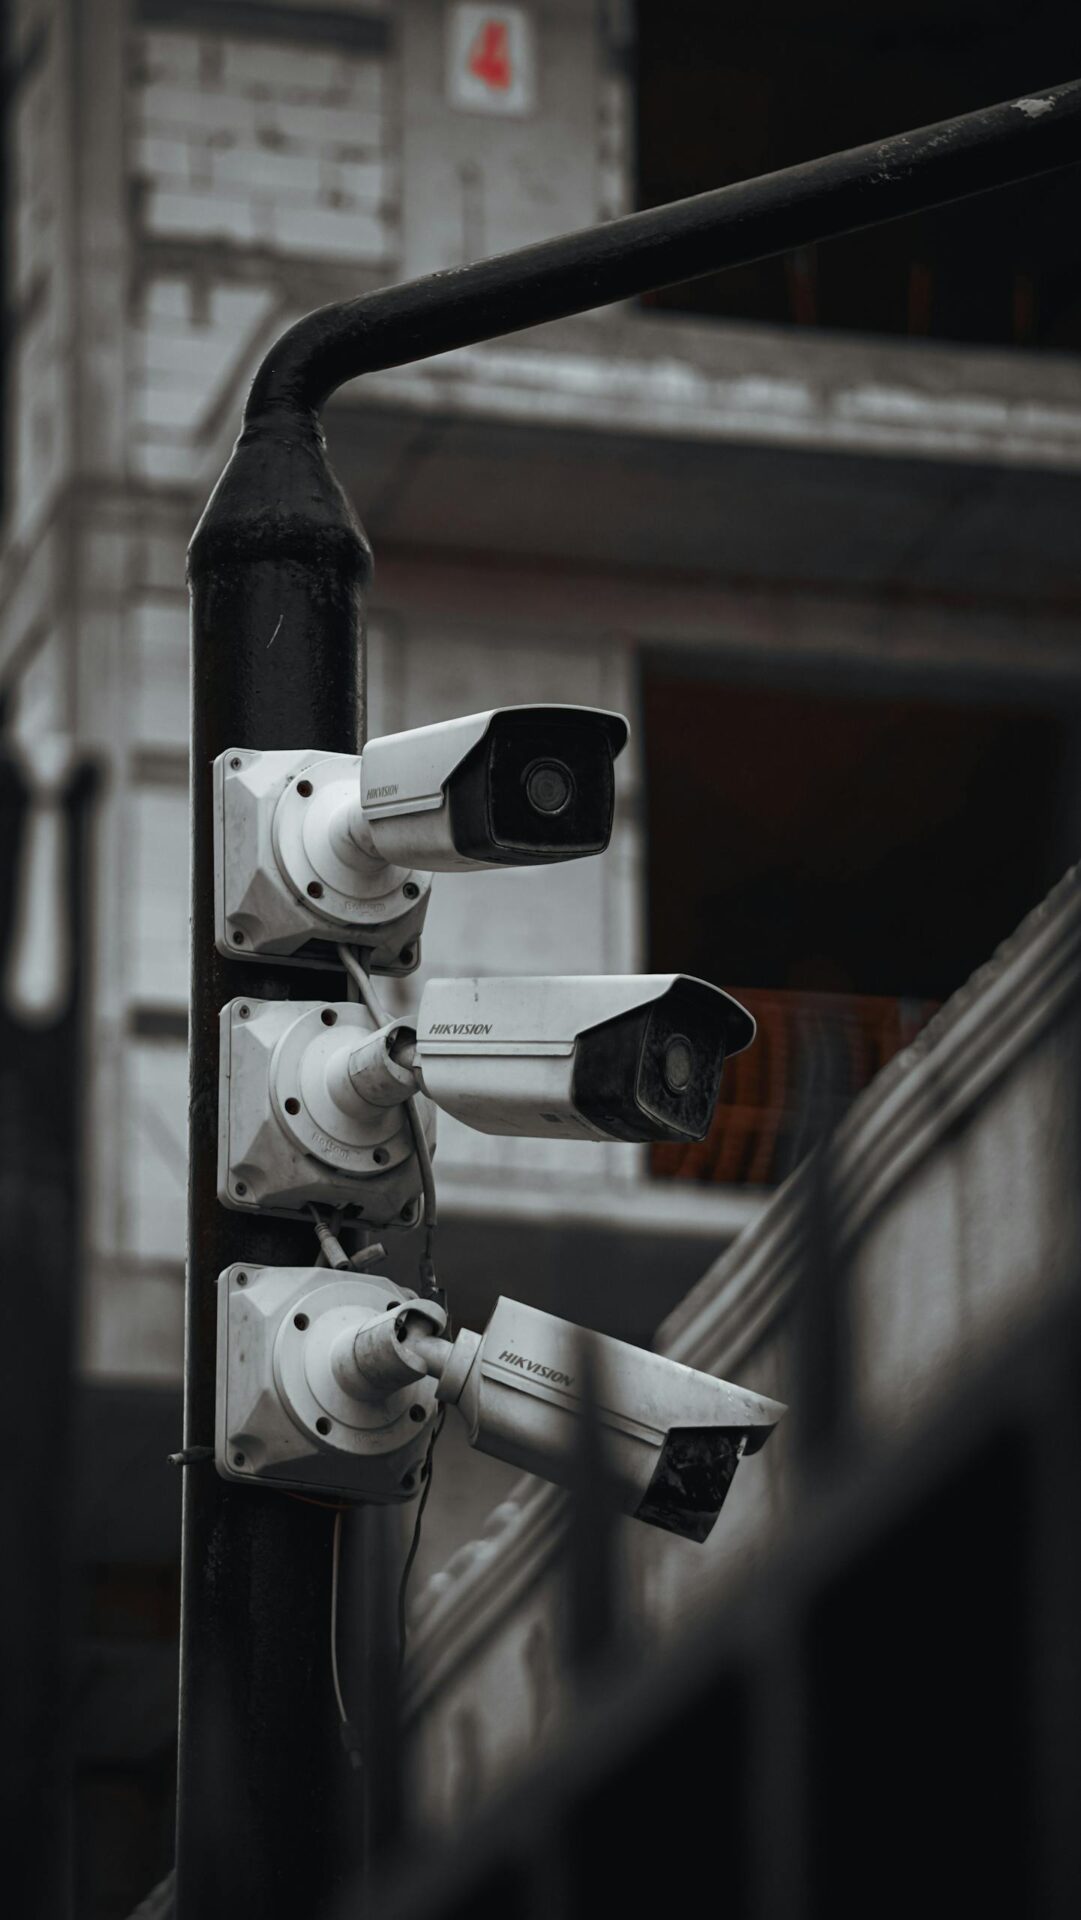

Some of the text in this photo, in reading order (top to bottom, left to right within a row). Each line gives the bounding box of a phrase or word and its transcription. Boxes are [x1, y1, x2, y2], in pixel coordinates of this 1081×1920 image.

[468, 19, 511, 92] 4
[429, 1023, 493, 1035] HIKVISION
[498, 1350, 575, 1387] HIKVISION
